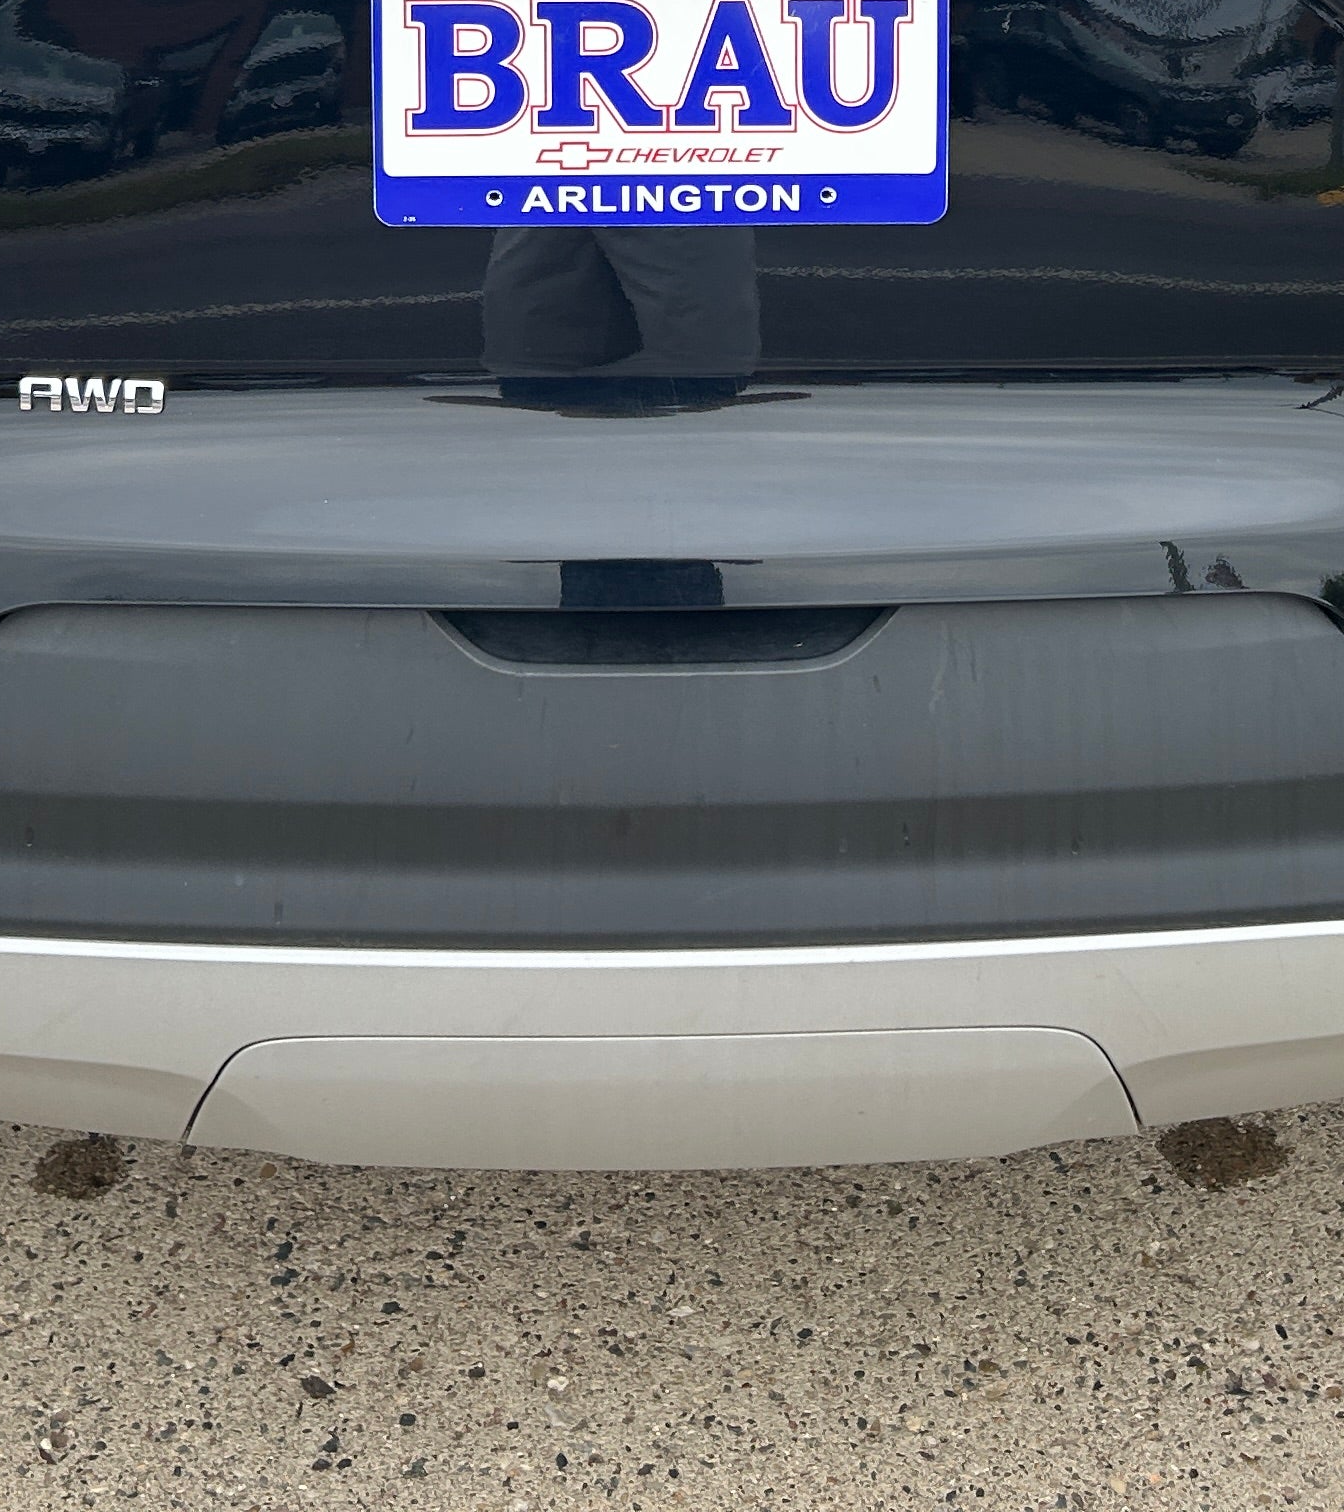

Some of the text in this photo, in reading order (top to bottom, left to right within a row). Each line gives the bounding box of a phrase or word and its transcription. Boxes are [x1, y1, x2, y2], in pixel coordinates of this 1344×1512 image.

[616, 147, 785, 164] CHEVROLET
[520, 184, 802, 213] ARLINGTON
[19, 376, 165, 414] AWD
